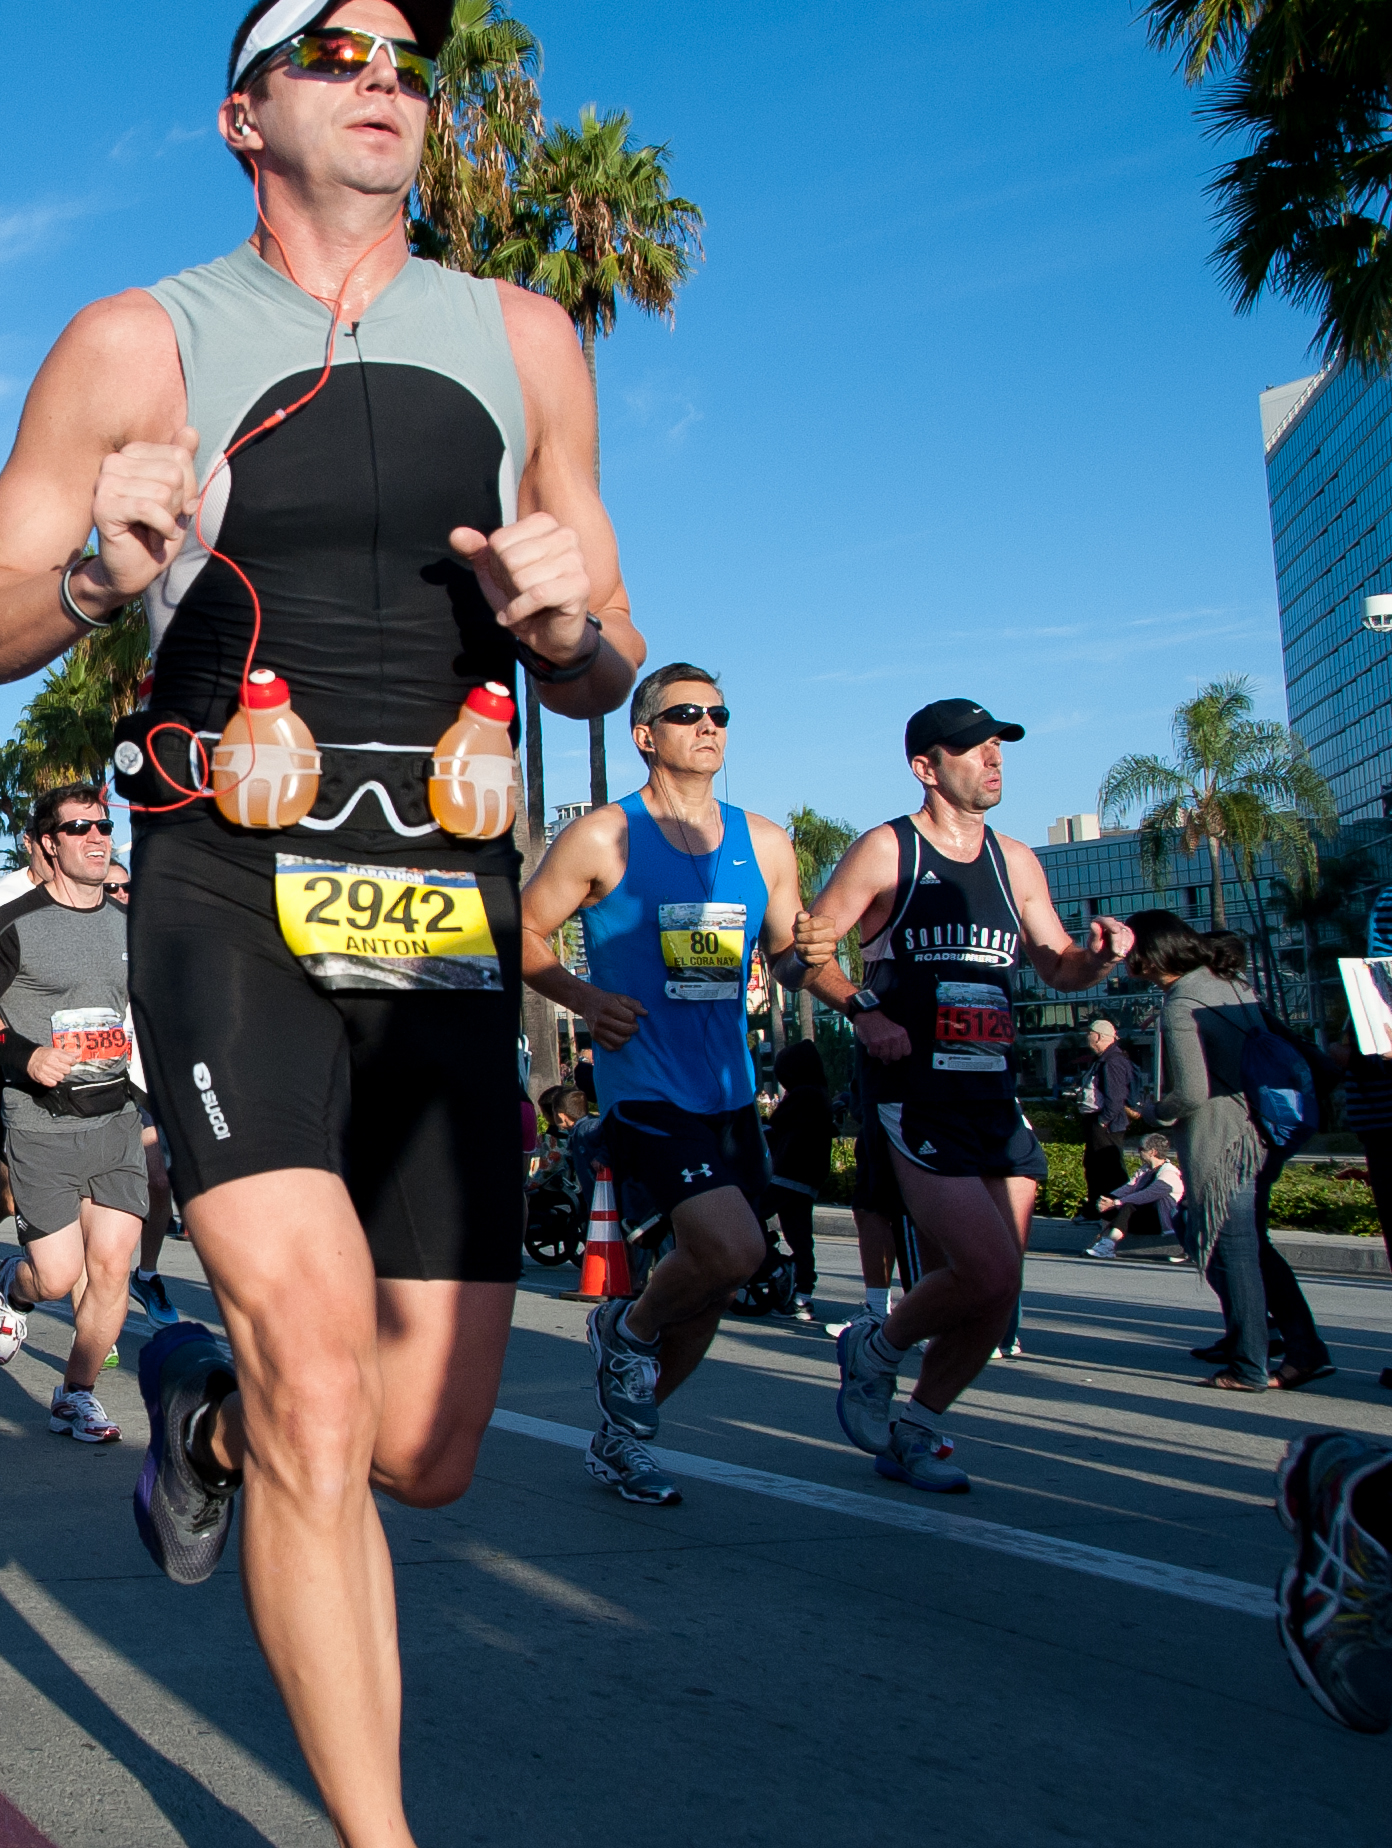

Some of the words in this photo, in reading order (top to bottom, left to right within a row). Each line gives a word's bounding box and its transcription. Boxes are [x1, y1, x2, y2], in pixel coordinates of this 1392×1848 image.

[347, 865, 425, 884] MARATHON
[304, 876, 464, 934] 2942
[346, 936, 430, 955] ANTON
[690, 931, 719, 955] 80
[56, 1029, 127, 1050] 11589
